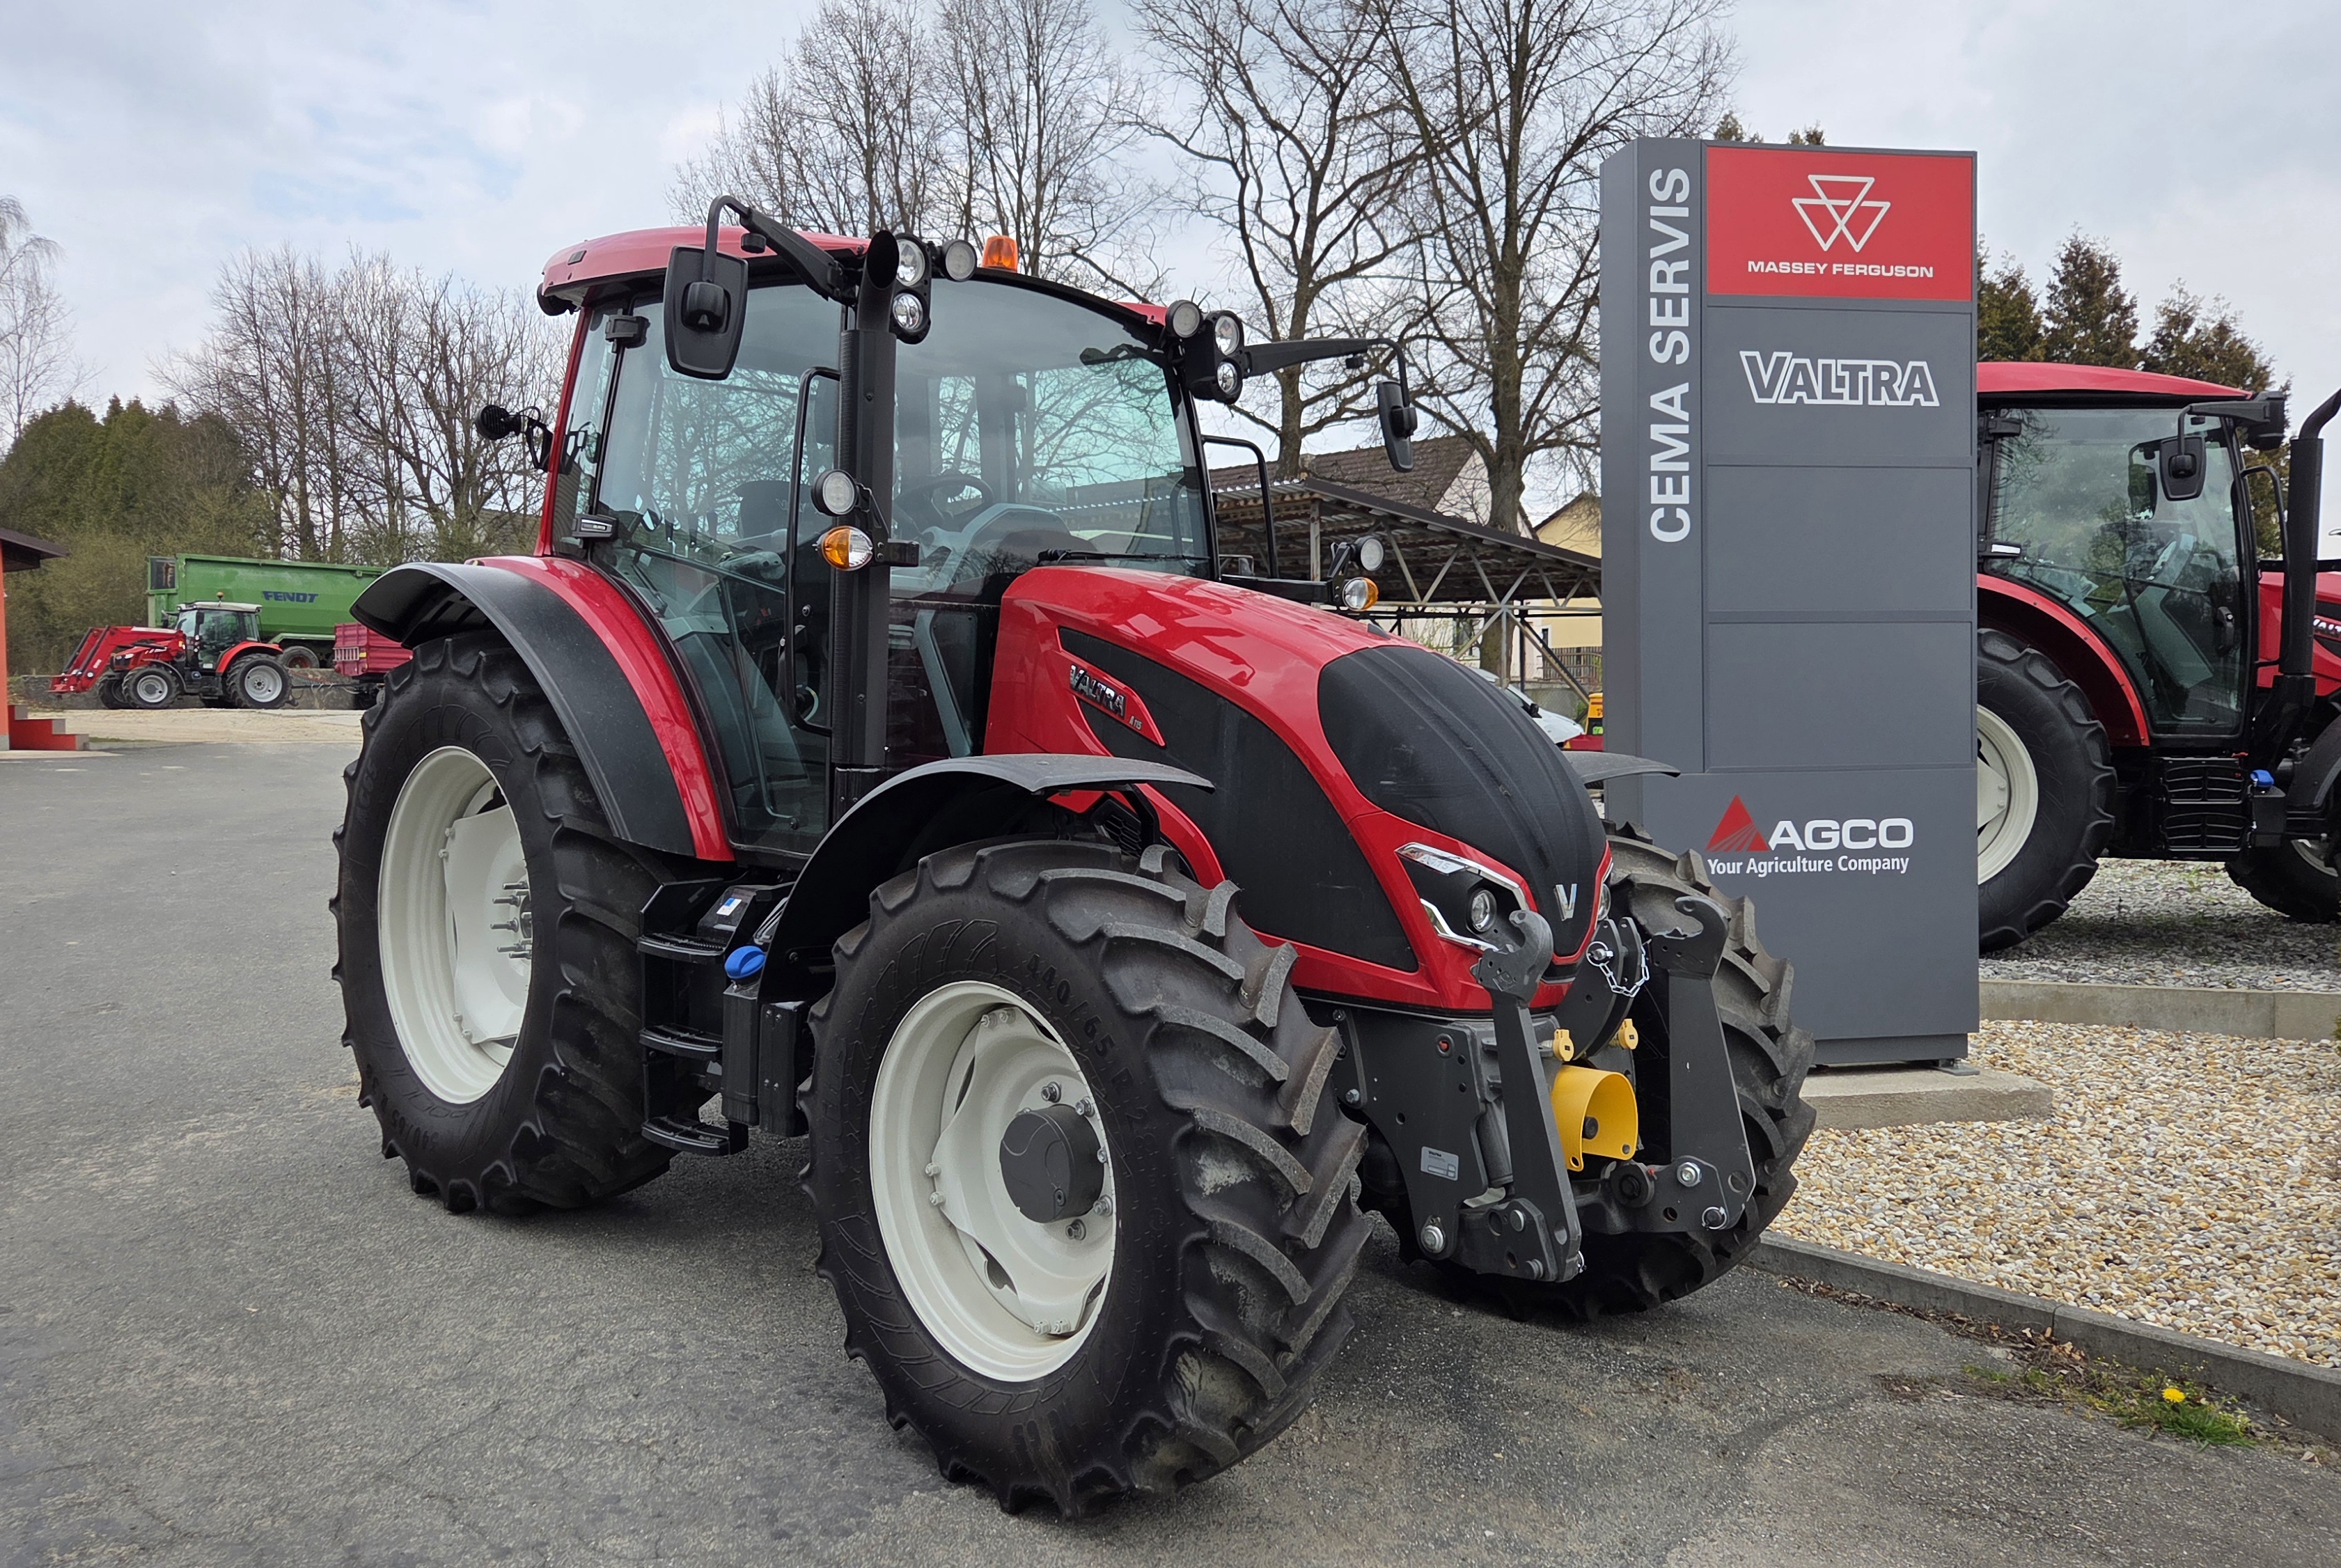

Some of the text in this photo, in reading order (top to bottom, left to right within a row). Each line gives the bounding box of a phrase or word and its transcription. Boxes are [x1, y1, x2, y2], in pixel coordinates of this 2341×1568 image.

[1748, 260, 1934, 278] MASSEY FERGUSON
[1649, 168, 1691, 542] CEMA SERVIS
[1739, 350, 1940, 407] VALTRA
[262, 590, 318, 603] FENDT
[1070, 664, 1126, 717] VALTRA
[1769, 817, 1913, 851] AGCO
[1707, 855, 1909, 878] Your Agriculture Company
[1553, 884, 1577, 921] V
[1026, 953, 1115, 1057] 440/65
